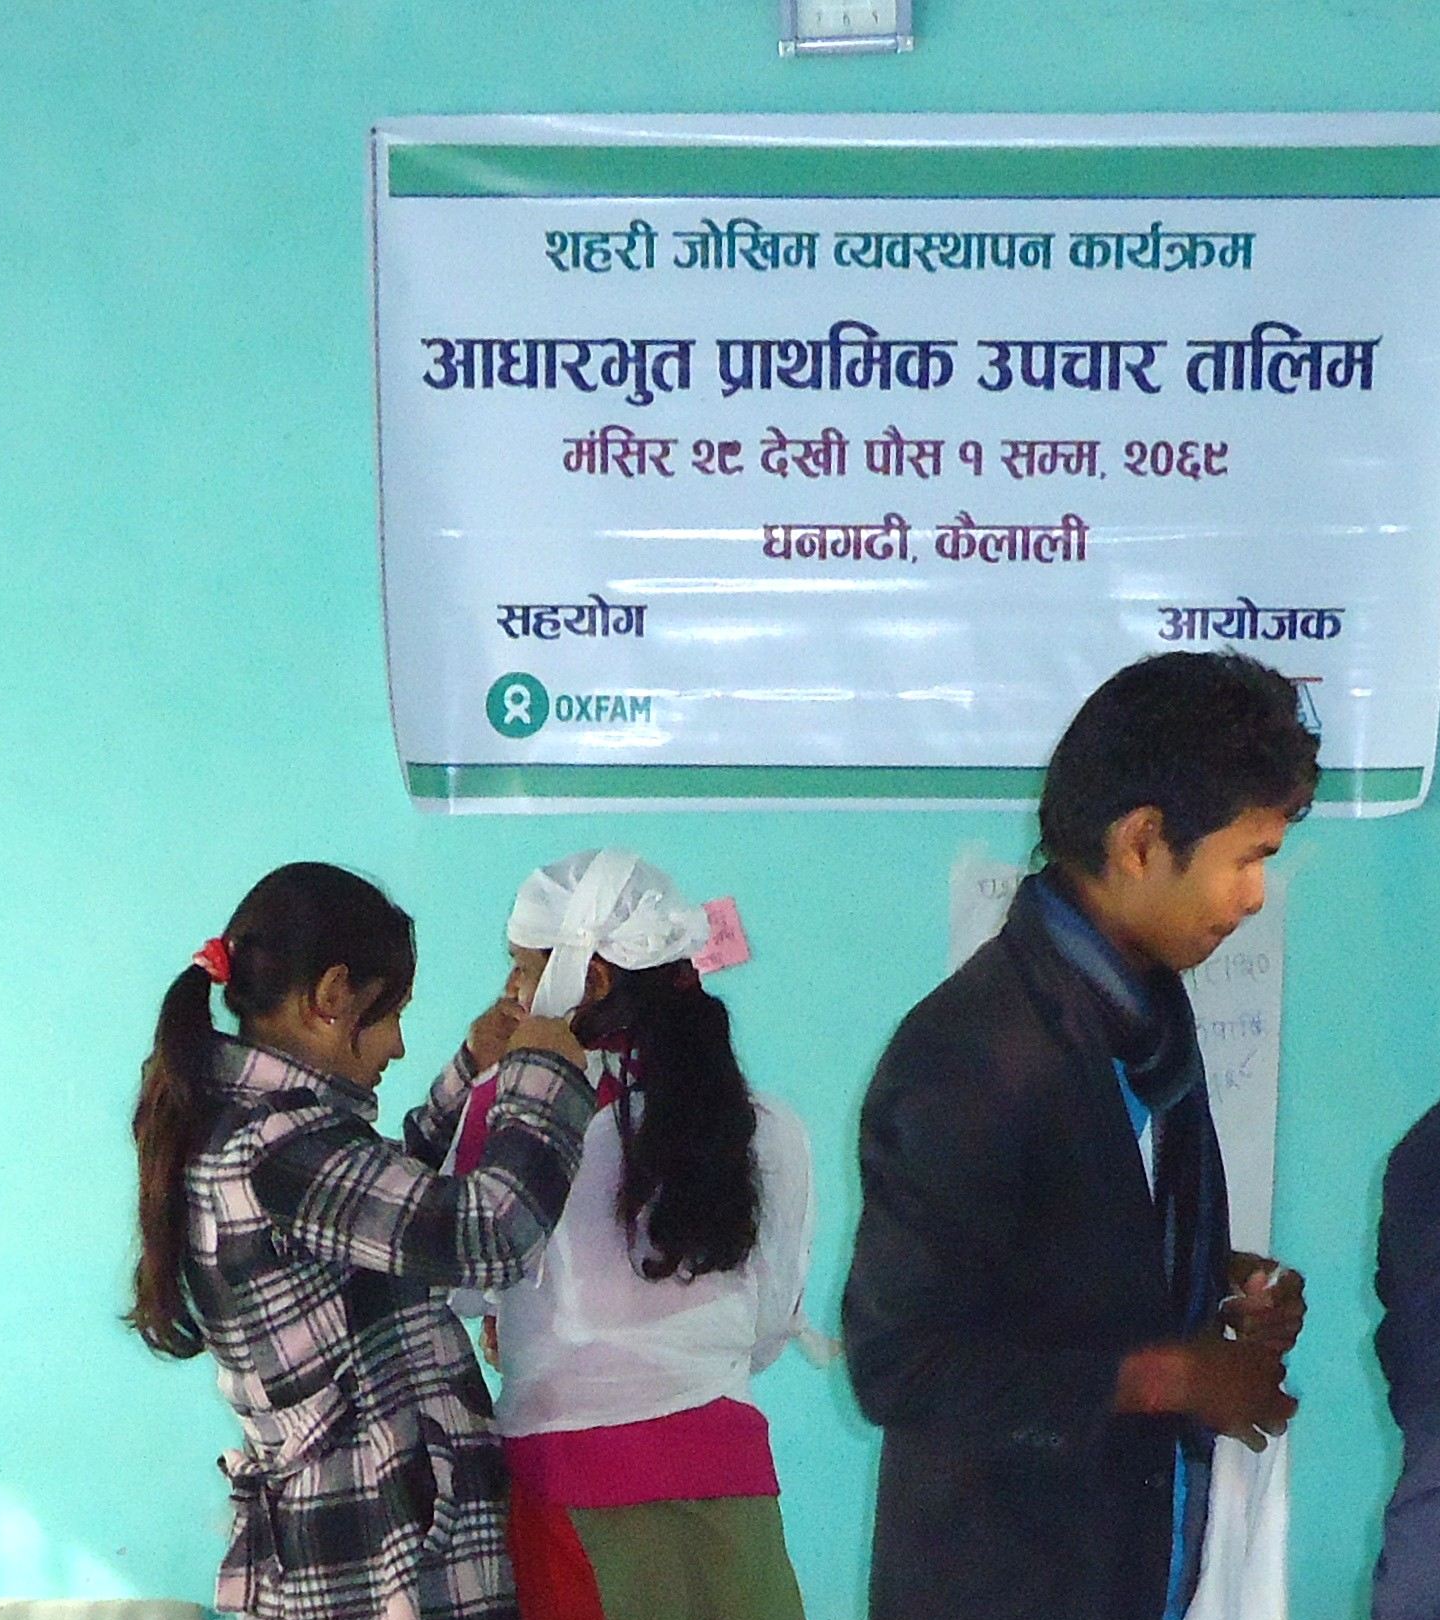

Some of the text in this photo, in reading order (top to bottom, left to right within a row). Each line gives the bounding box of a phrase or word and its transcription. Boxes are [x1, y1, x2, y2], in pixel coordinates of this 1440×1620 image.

[544, 217, 1258, 274] शहरी जोखिम व्यवस्थापन कार्यक्रम
[420, 319, 1383, 407] आधारभुत प्राथमिक उपचार तालिम
[562, 424, 679, 478] मंसिर
[759, 426, 851, 479] देखी
[864, 424, 946, 479] पौस
[958, 440, 983, 476] १
[1123, 439, 1229, 481] २०६९
[934, 510, 1090, 565] कैलाली
[496, 593, 648, 640] सहयोग
[1158, 595, 1346, 641] आयोजक
[555, 694, 652, 724] OXFAM
